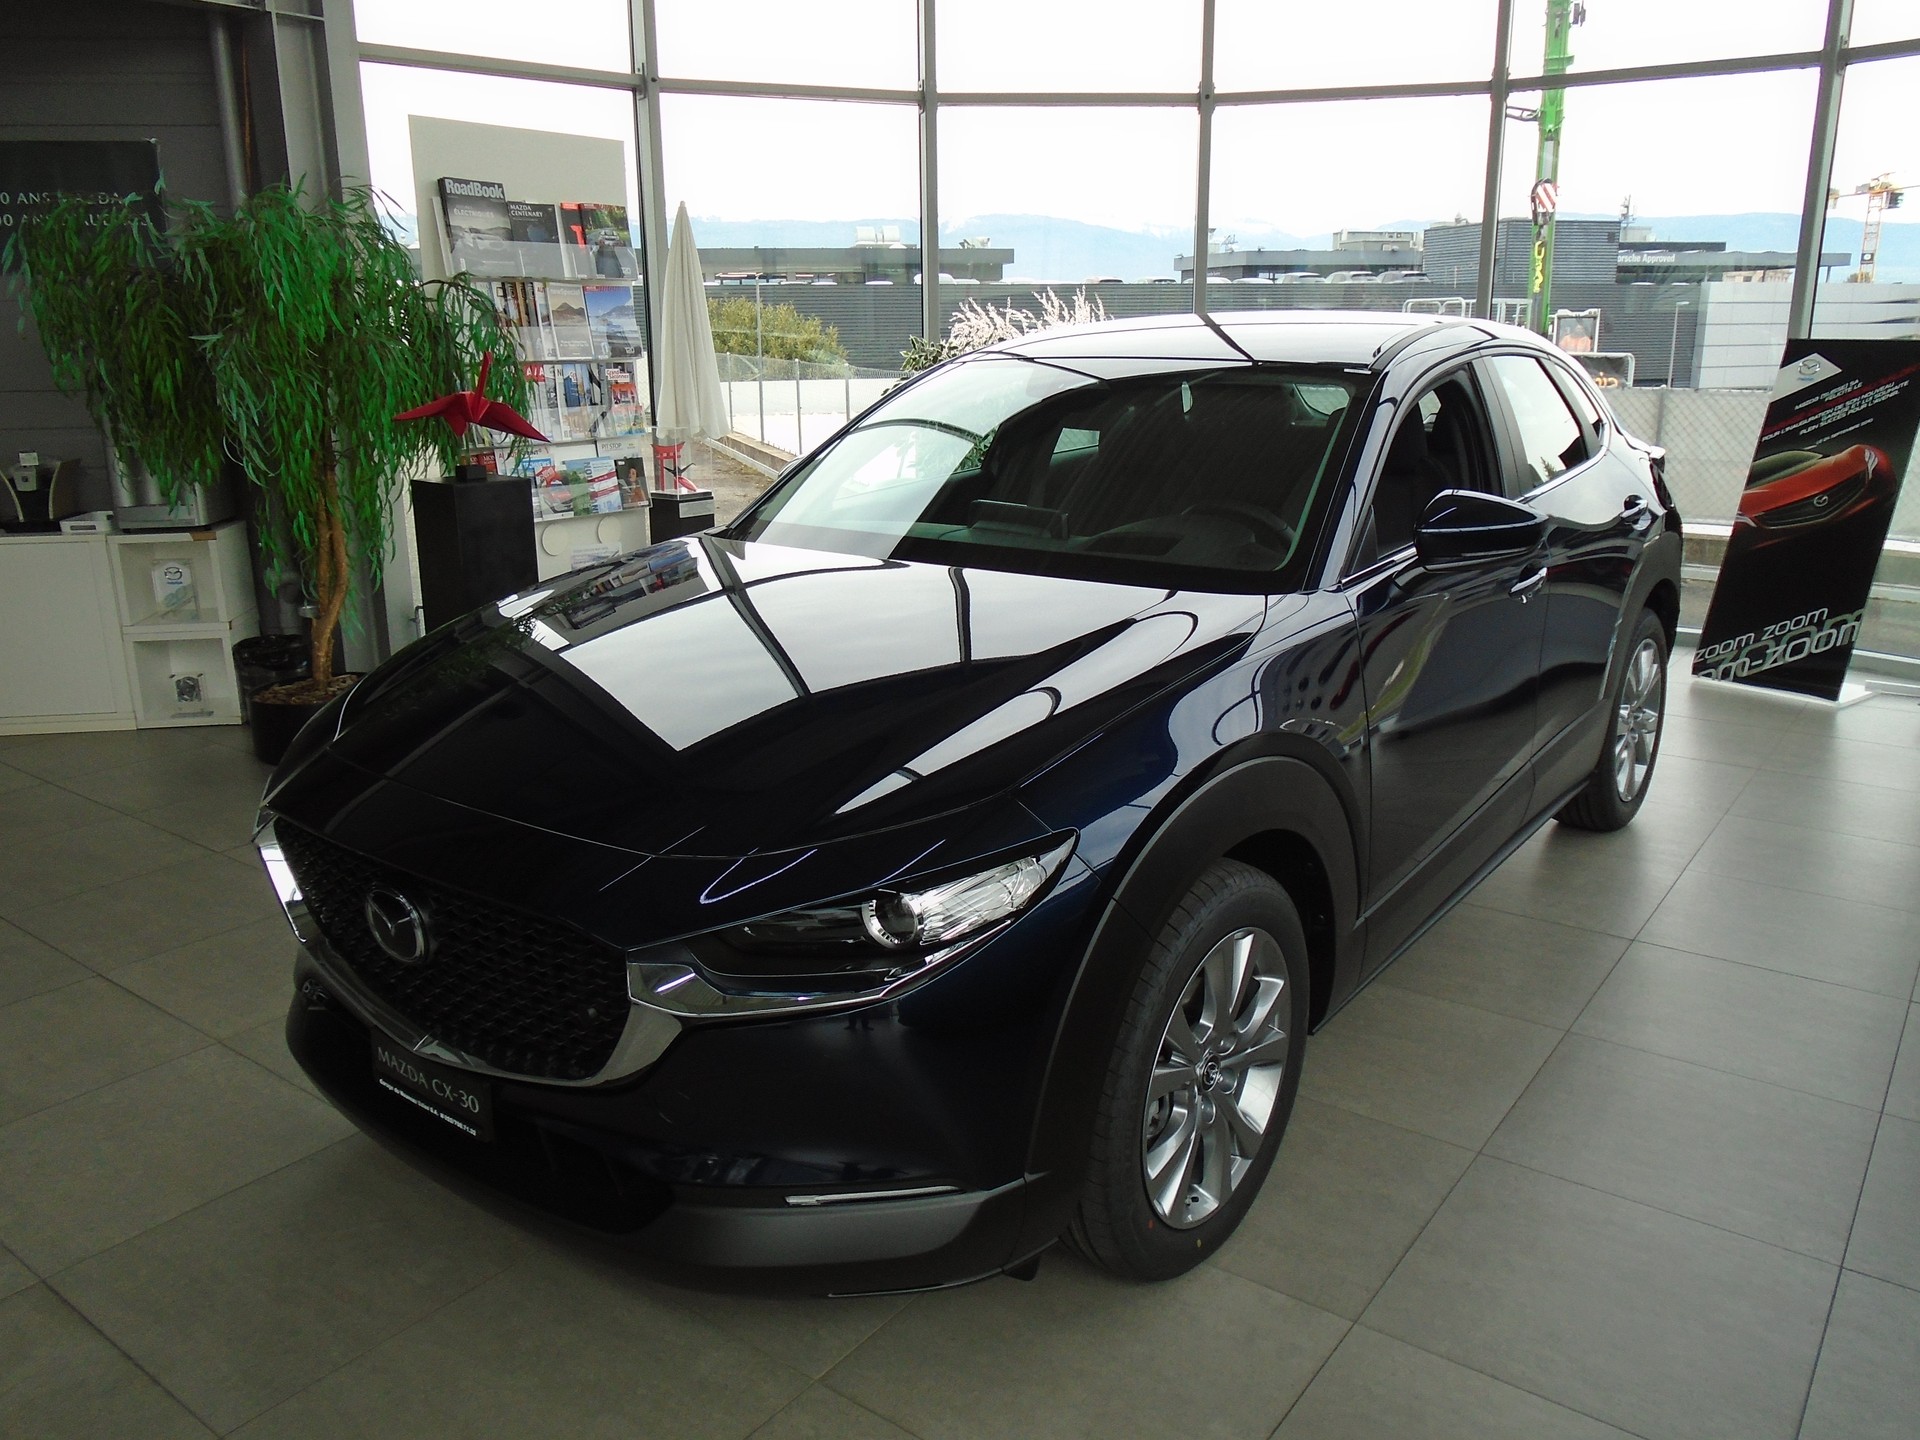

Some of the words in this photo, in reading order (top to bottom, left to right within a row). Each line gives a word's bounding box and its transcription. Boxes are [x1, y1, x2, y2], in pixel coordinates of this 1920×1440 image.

[444, 178, 504, 199] RoadBook
[510, 210, 543, 218] CENTENARY
[1617, 254, 1641, 263] orsche
[1642, 253, 1676, 264] Approved
[1761, 428, 1780, 442] POUR
[1695, 632, 1755, 663] zoom
[1761, 607, 1829, 641] zoom
[377, 1046, 428, 1089] MAZDA
[432, 1079, 479, 1113] CX-30
